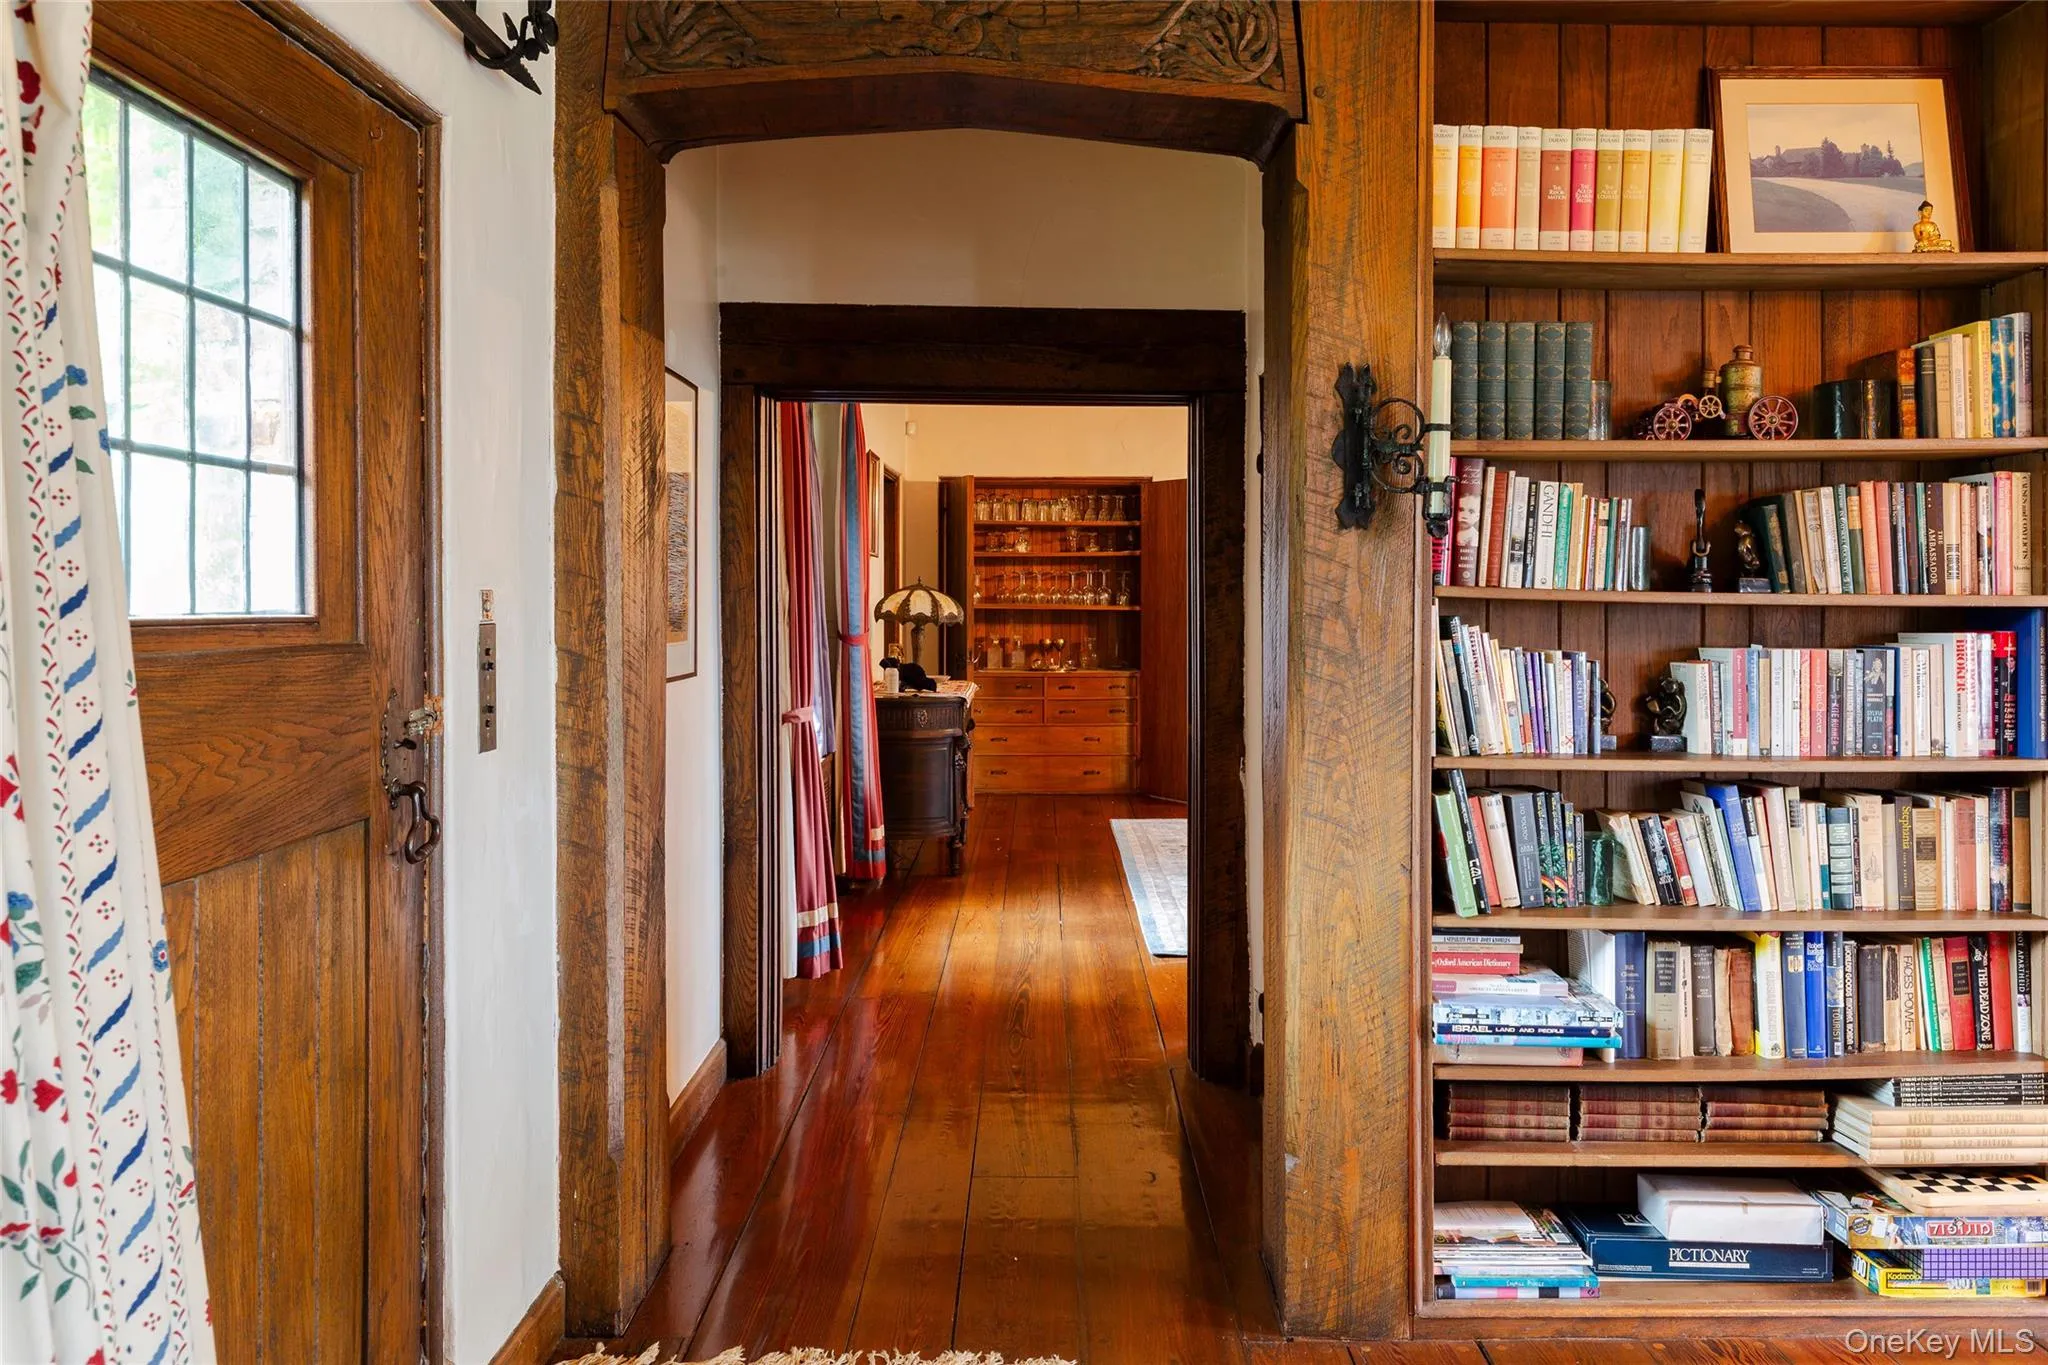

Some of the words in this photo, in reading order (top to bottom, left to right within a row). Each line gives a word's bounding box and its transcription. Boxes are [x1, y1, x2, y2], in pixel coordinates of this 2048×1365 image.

[1541, 484, 1556, 538] GANDHI
[1928, 529, 1939, 585] AMBASSADOR
[1956, 639, 1968, 692] BROKER
[1899, 806, 1912, 849] Stephania
[1437, 957, 1457, 967] Oxford
[1458, 957, 1482, 967] American
[1483, 957, 1512, 969] Dictionary
[1903, 955, 1914, 989] FACES
[1978, 967, 1988, 988] THE
[2018, 949, 2027, 993] APARTHEID
[1845, 973, 1853, 997] GOODS
[1979, 988, 1989, 1014] DEAD
[1452, 1024, 1492, 1034] ISRAEL
[1832, 1007, 1842, 1041] TOURIST
[1903, 992, 1915, 1036] POWER
[1981, 1014, 1991, 1042] ZONE
[1669, 1248, 1749, 1263] PICTIONARY
